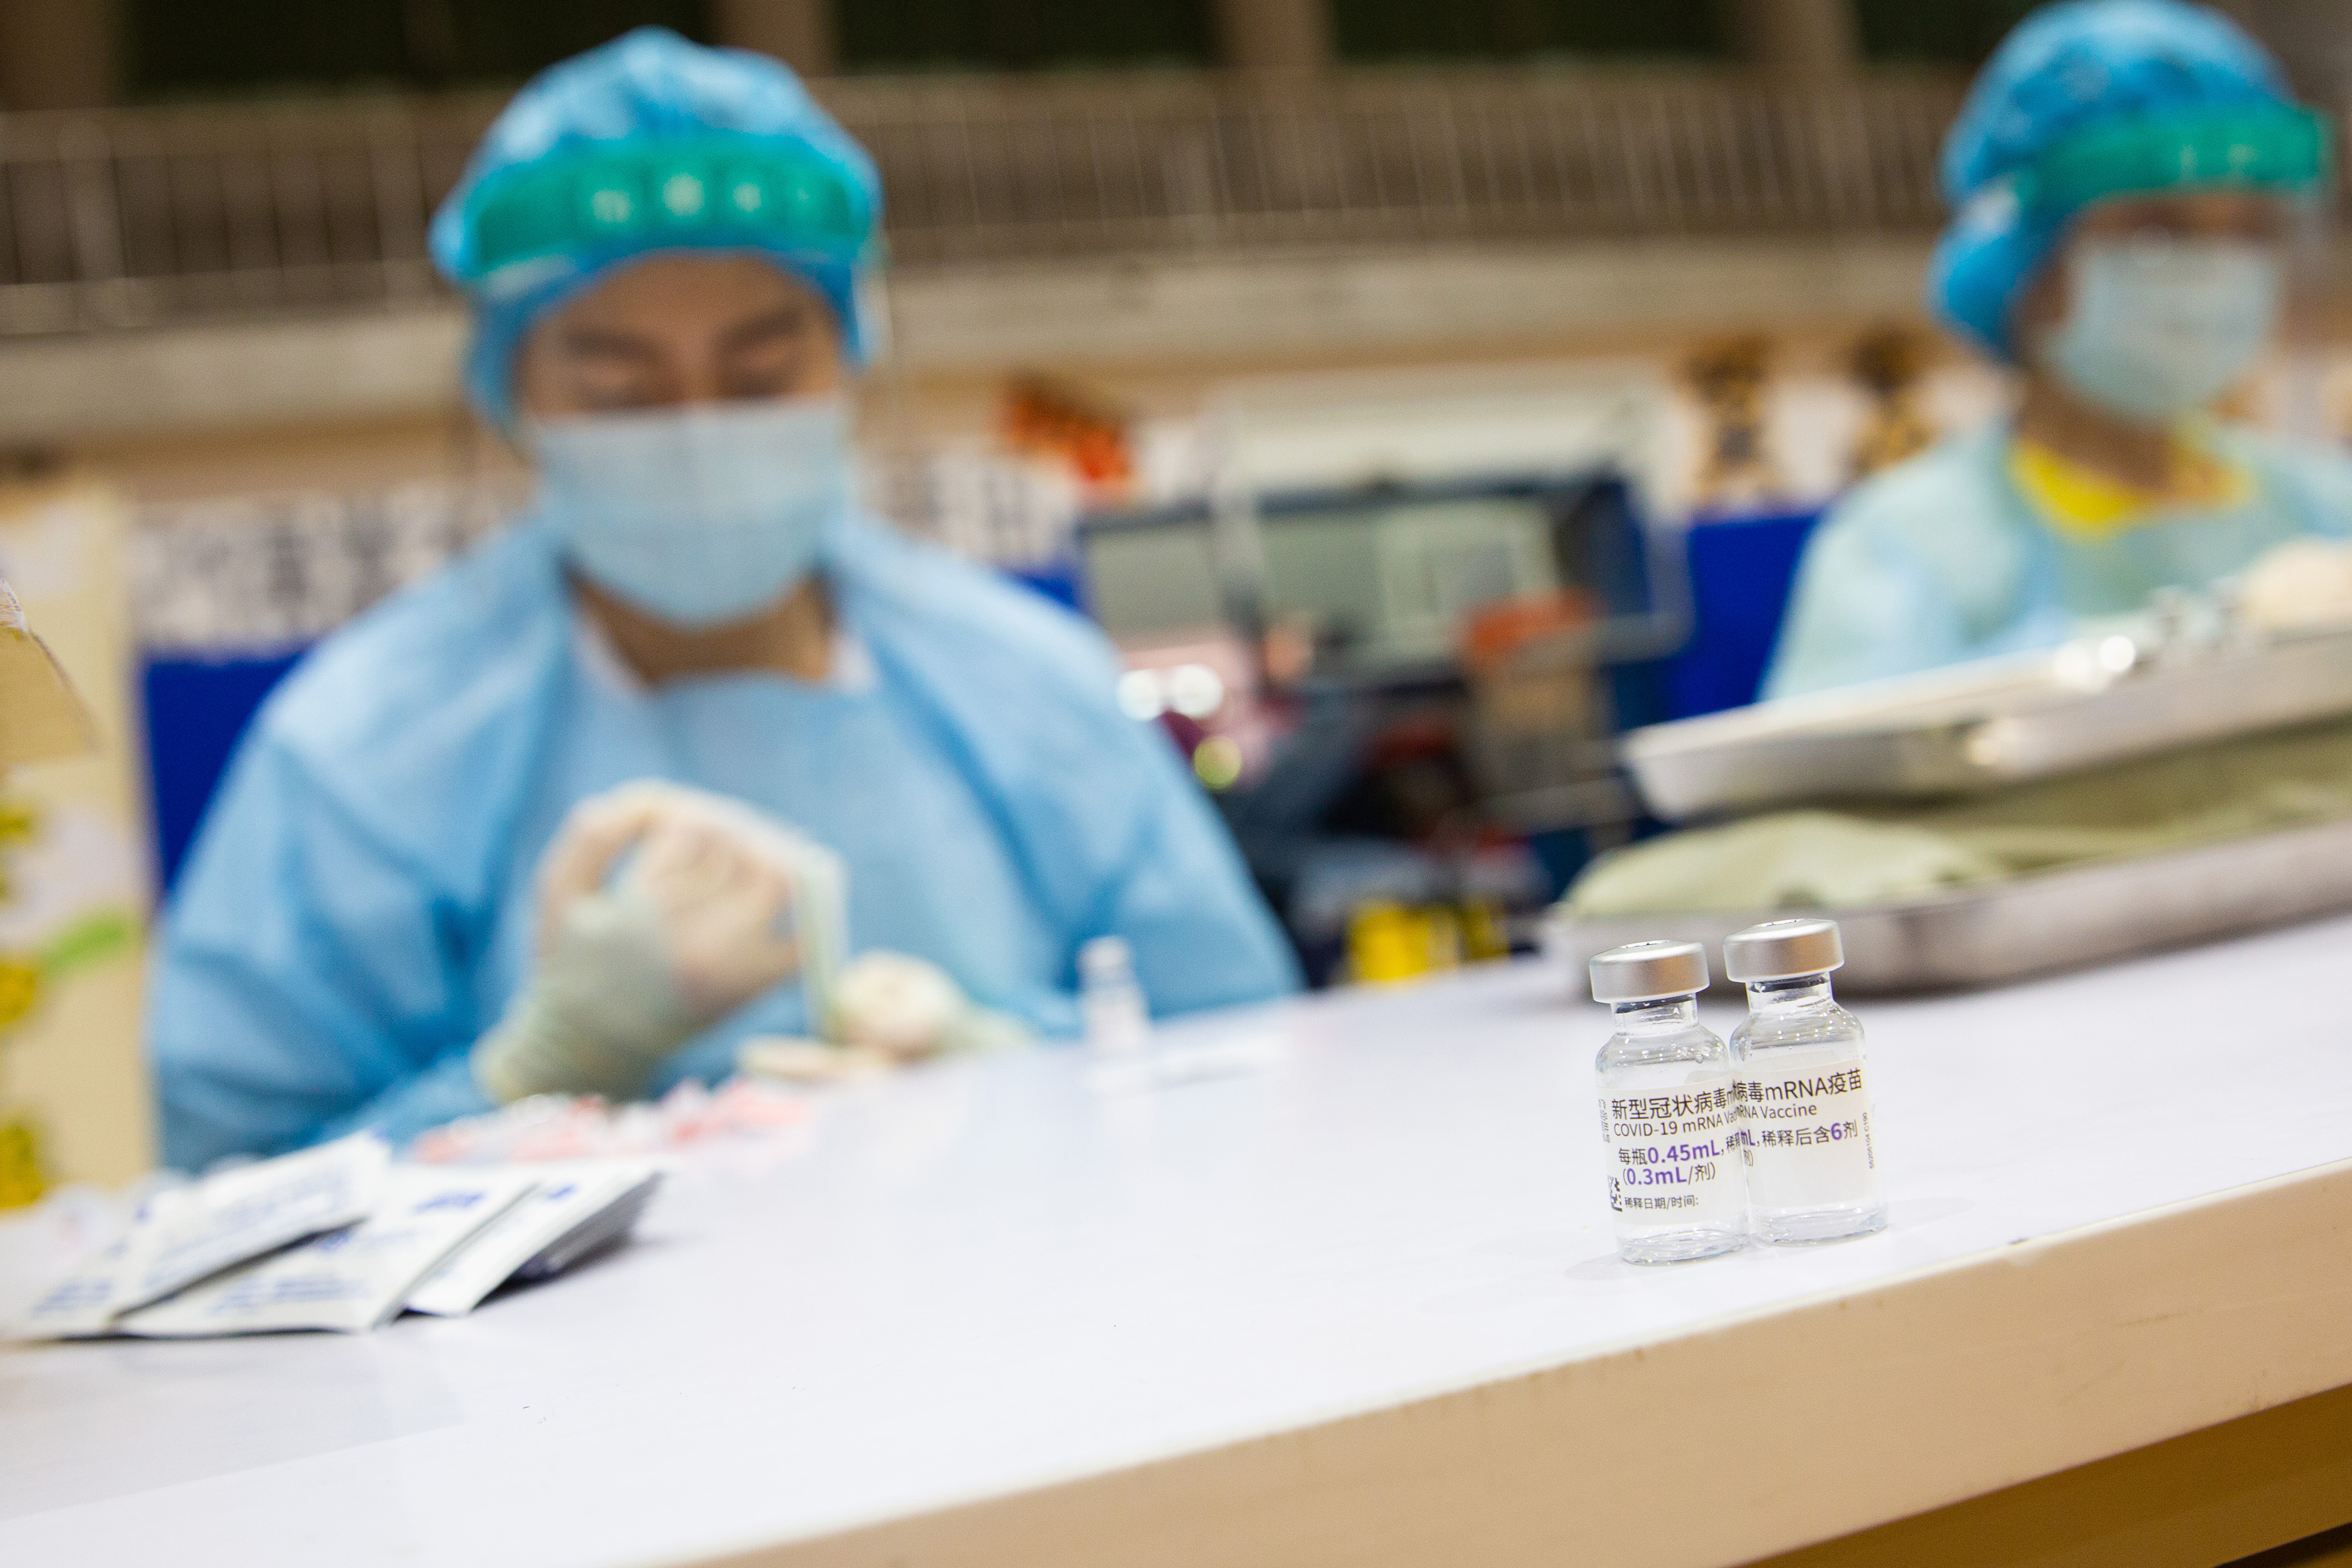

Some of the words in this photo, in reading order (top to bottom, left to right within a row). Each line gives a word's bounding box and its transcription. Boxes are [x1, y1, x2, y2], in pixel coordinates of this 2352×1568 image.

[1760, 1103, 1817, 1119] Vaccine
[1614, 1121, 1678, 1137] COVID-19
[1683, 1113, 1724, 1133] mRNA
[1623, 1162, 1715, 1186] (0.3mL/剂)
[1624, 1195, 1699, 1209] 稀释日期/时间:
